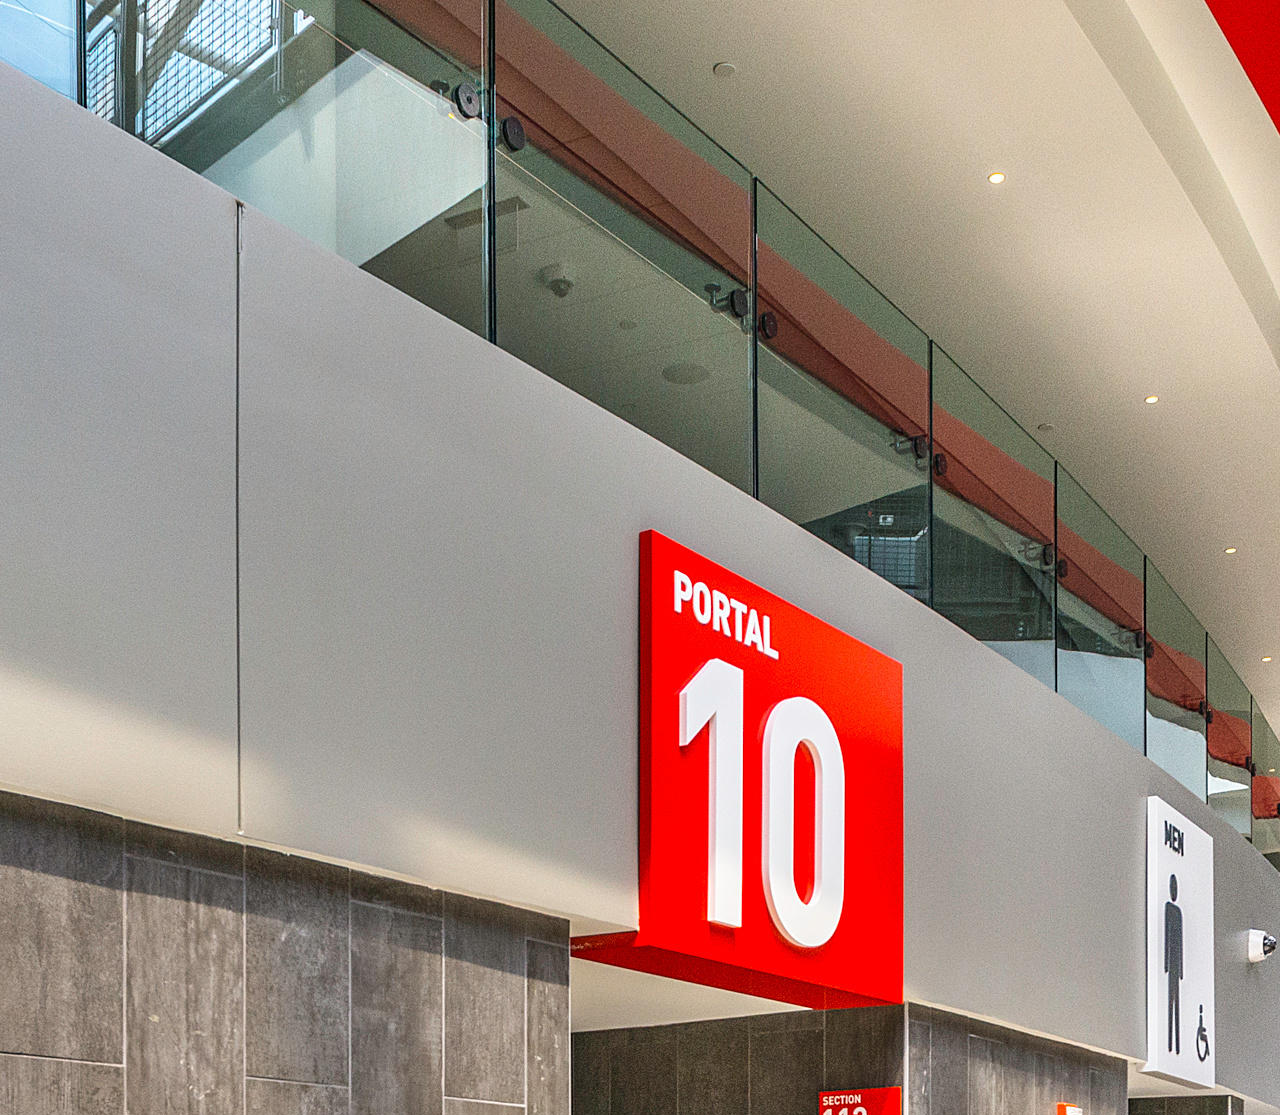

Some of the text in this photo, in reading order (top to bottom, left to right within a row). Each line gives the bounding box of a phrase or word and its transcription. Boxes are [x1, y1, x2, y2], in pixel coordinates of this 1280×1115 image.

[673, 570, 779, 660] PORTAL
[679, 657, 845, 949] 10
[1164, 820, 1185, 857] MEN
[822, 1094, 862, 1106] SECTION
